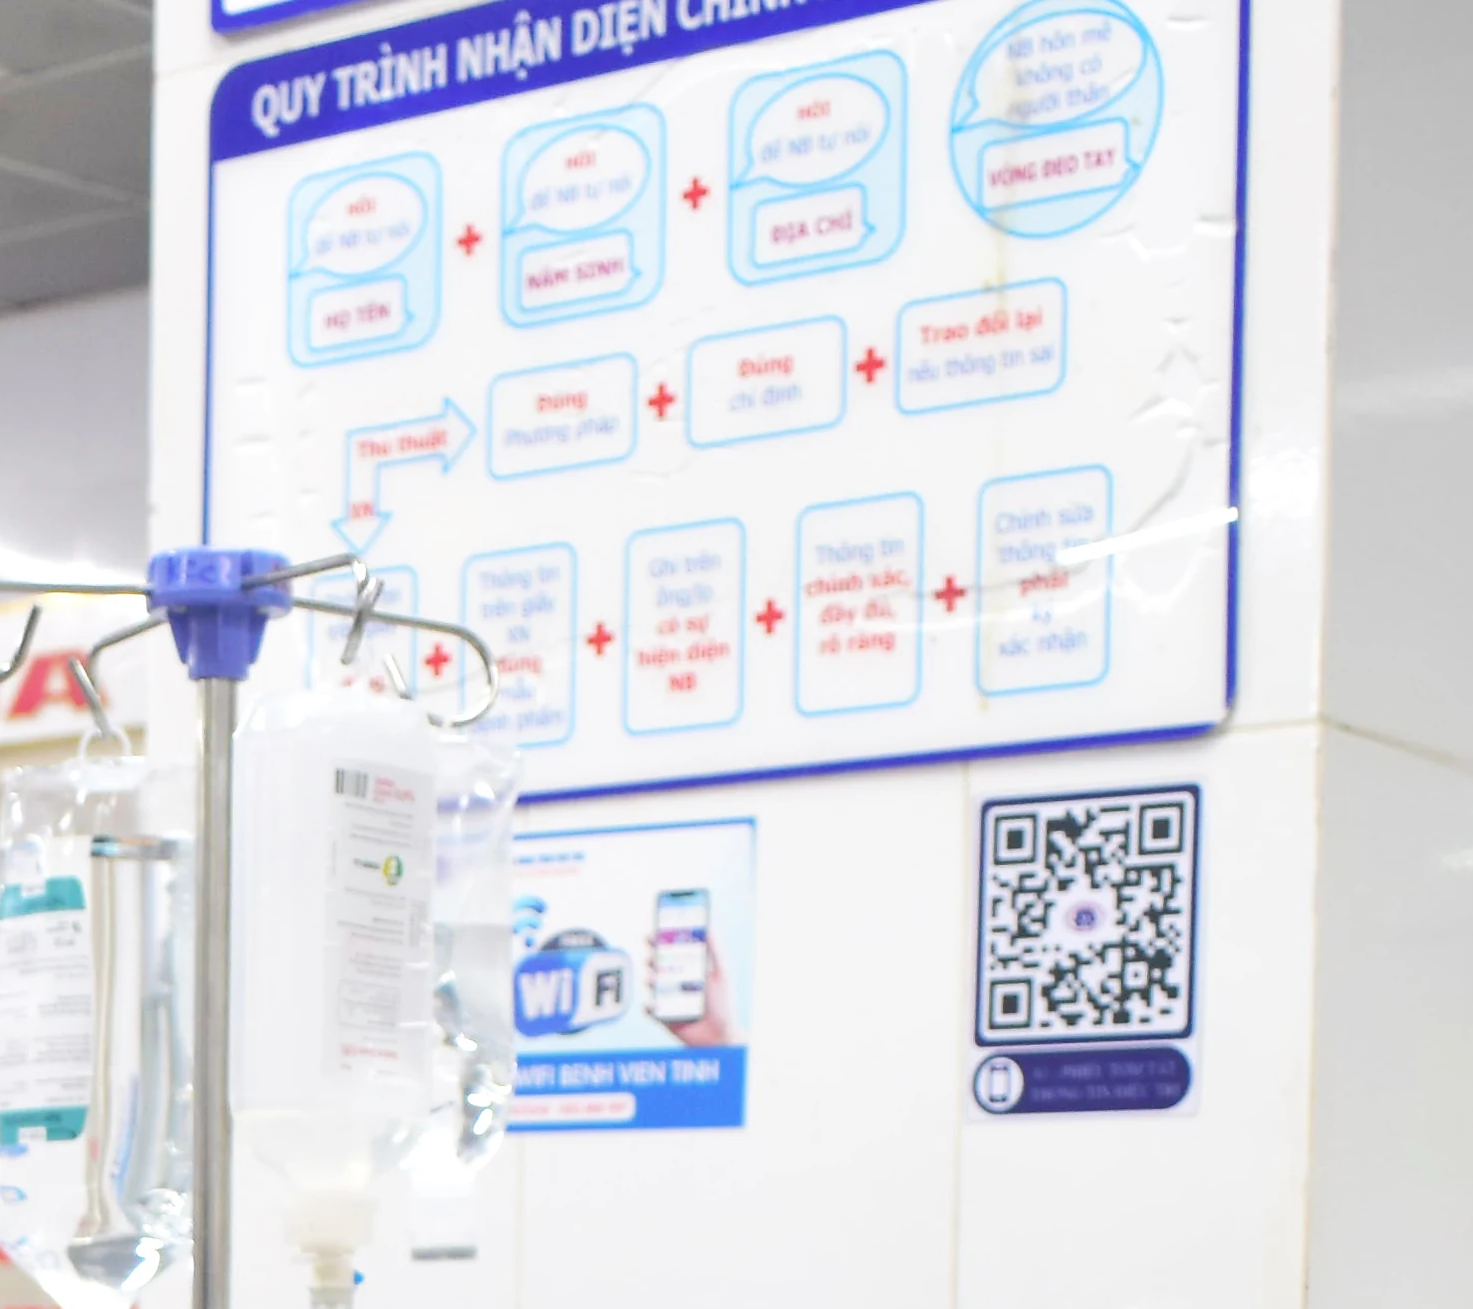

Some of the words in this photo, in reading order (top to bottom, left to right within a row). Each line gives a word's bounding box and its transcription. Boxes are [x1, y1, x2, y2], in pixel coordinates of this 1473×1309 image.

[253, 72, 325, 137] QUY
[335, 42, 448, 109] TRÌNH
[457, 11, 561, 82] NHẬN
[571, 0, 668, 57] DIỆN
